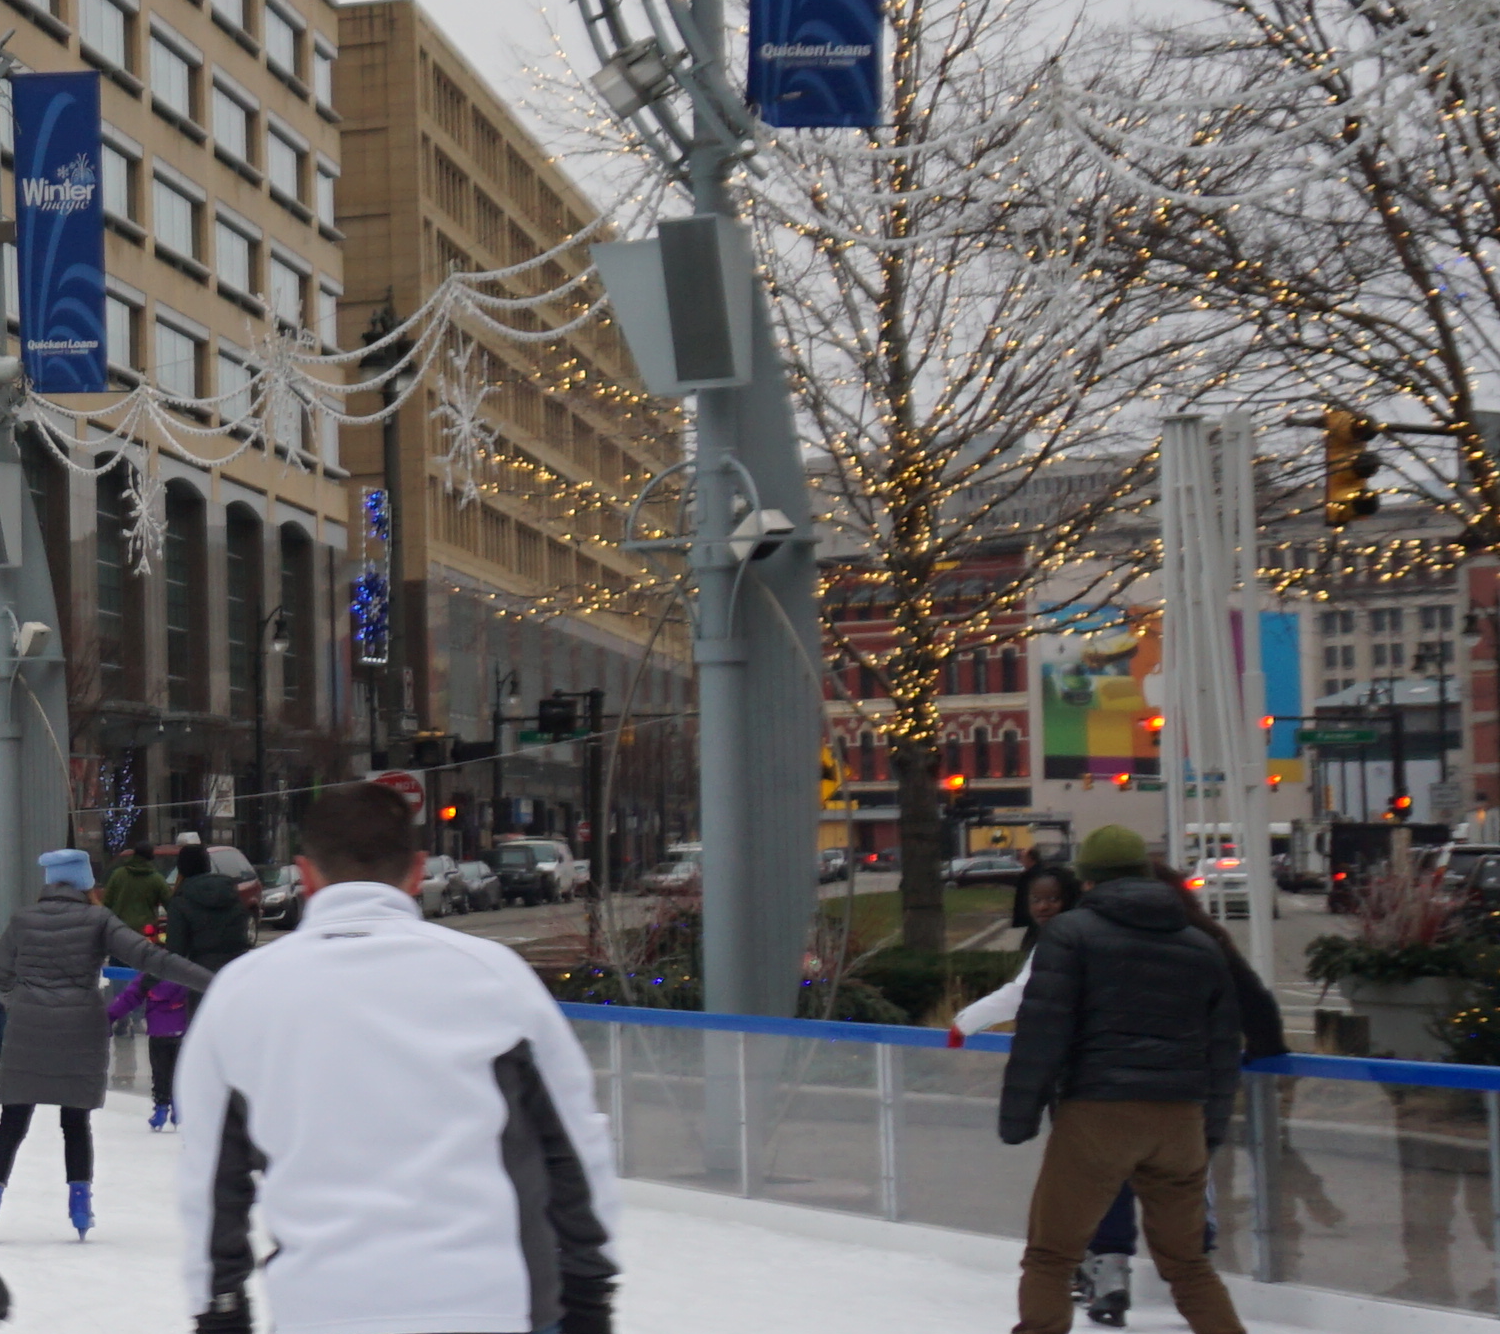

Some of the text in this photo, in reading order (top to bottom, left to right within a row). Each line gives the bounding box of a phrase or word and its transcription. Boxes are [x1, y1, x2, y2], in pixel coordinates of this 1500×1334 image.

[761, 41, 871, 59] Quicken Loans
[22, 177, 96, 206] Winter
[41, 199, 90, 215] magic
[27, 338, 99, 351] Quicken Loans
